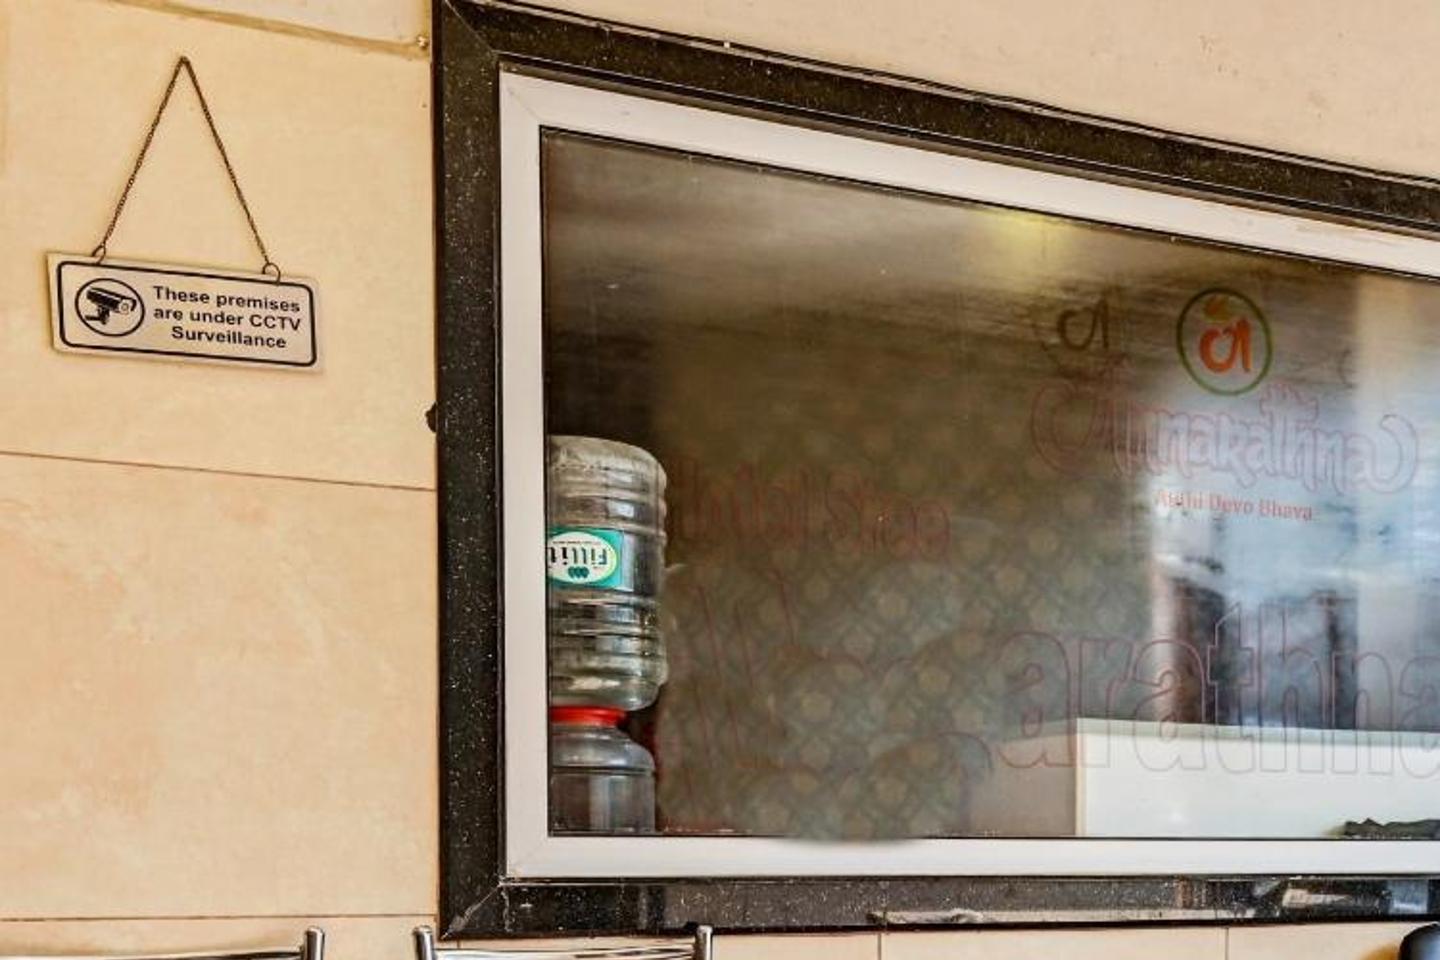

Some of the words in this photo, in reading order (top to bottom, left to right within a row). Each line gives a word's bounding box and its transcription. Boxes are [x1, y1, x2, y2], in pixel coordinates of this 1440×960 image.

[152, 285, 210, 304] These
[216, 293, 301, 312] premises
[153, 308, 183, 321] are
[190, 310, 244, 325] under
[250, 314, 301, 331] CCTV
[171, 325, 287, 348] Surveillance
